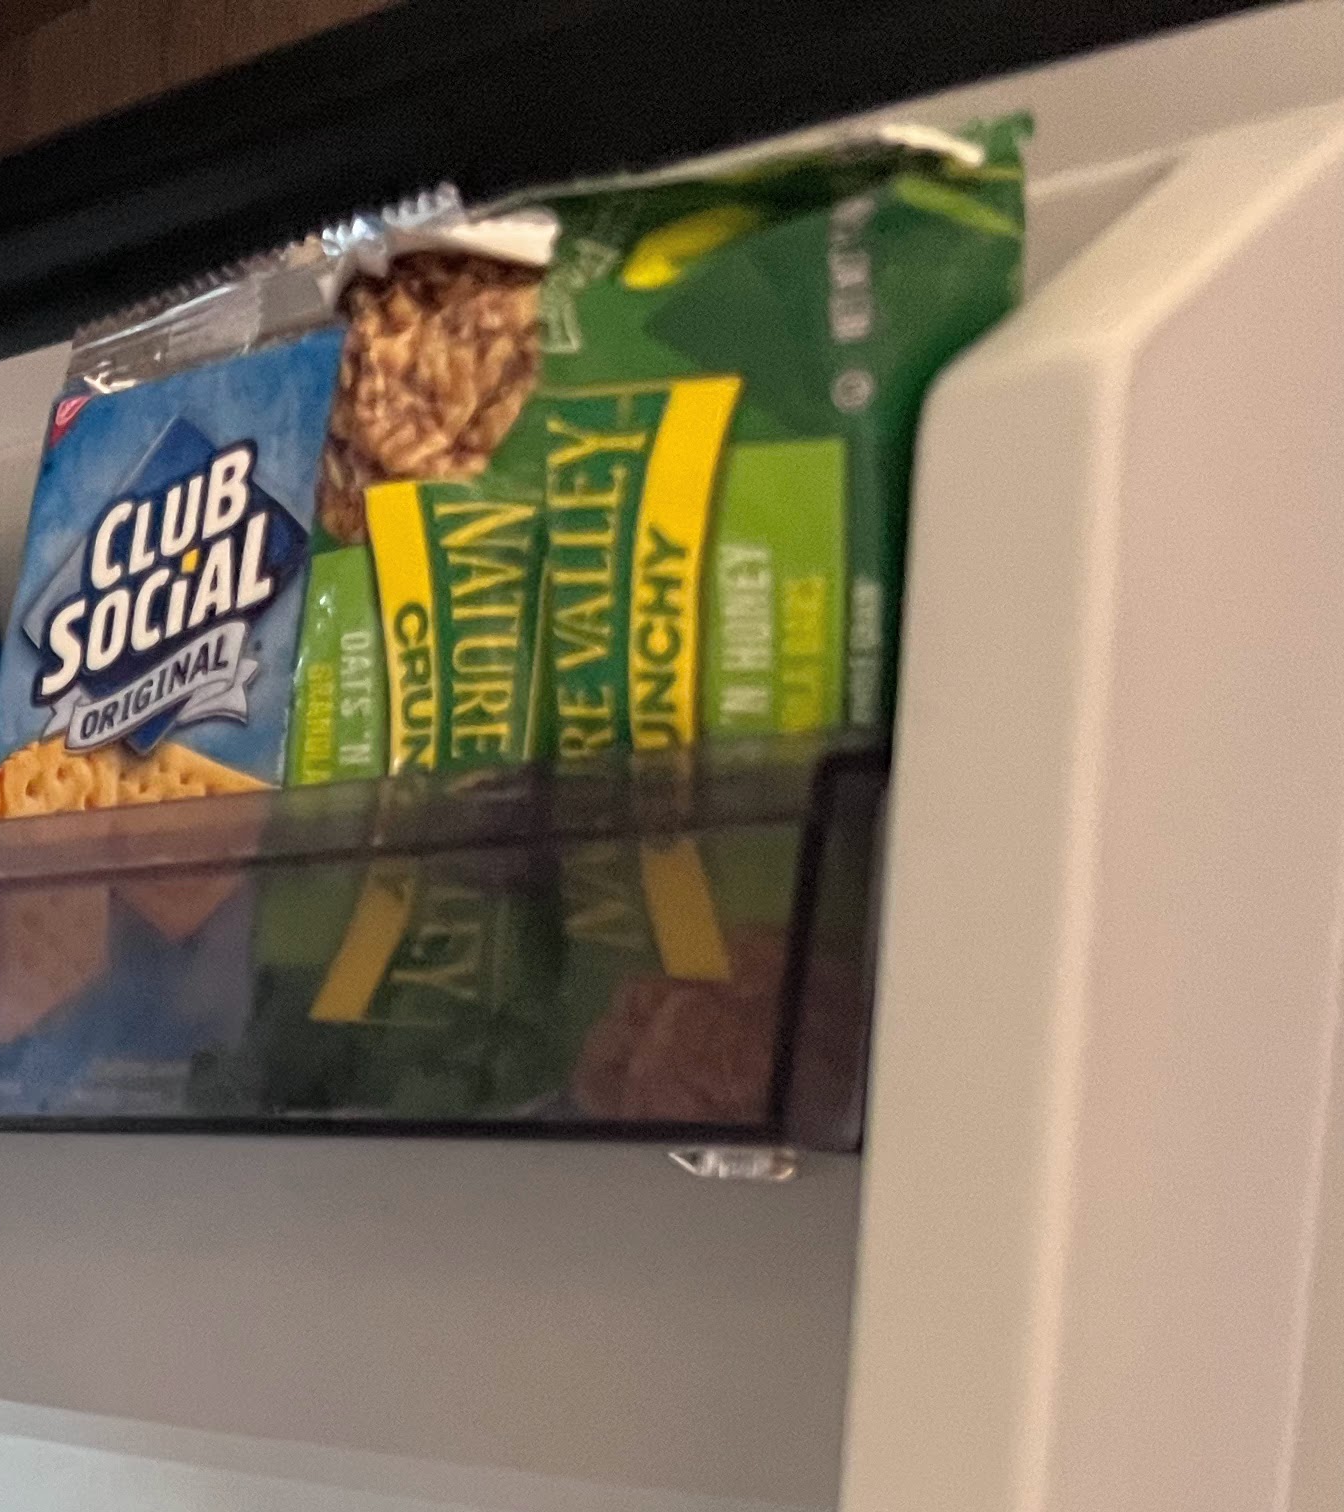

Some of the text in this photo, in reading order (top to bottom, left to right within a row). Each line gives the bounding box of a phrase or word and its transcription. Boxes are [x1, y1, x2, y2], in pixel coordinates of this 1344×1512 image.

[91, 447, 252, 590] CLUB
[546, 416, 646, 671] VALLEY
[80, 627, 230, 739] ORIGINAL
[434, 502, 536, 759] NATURE
